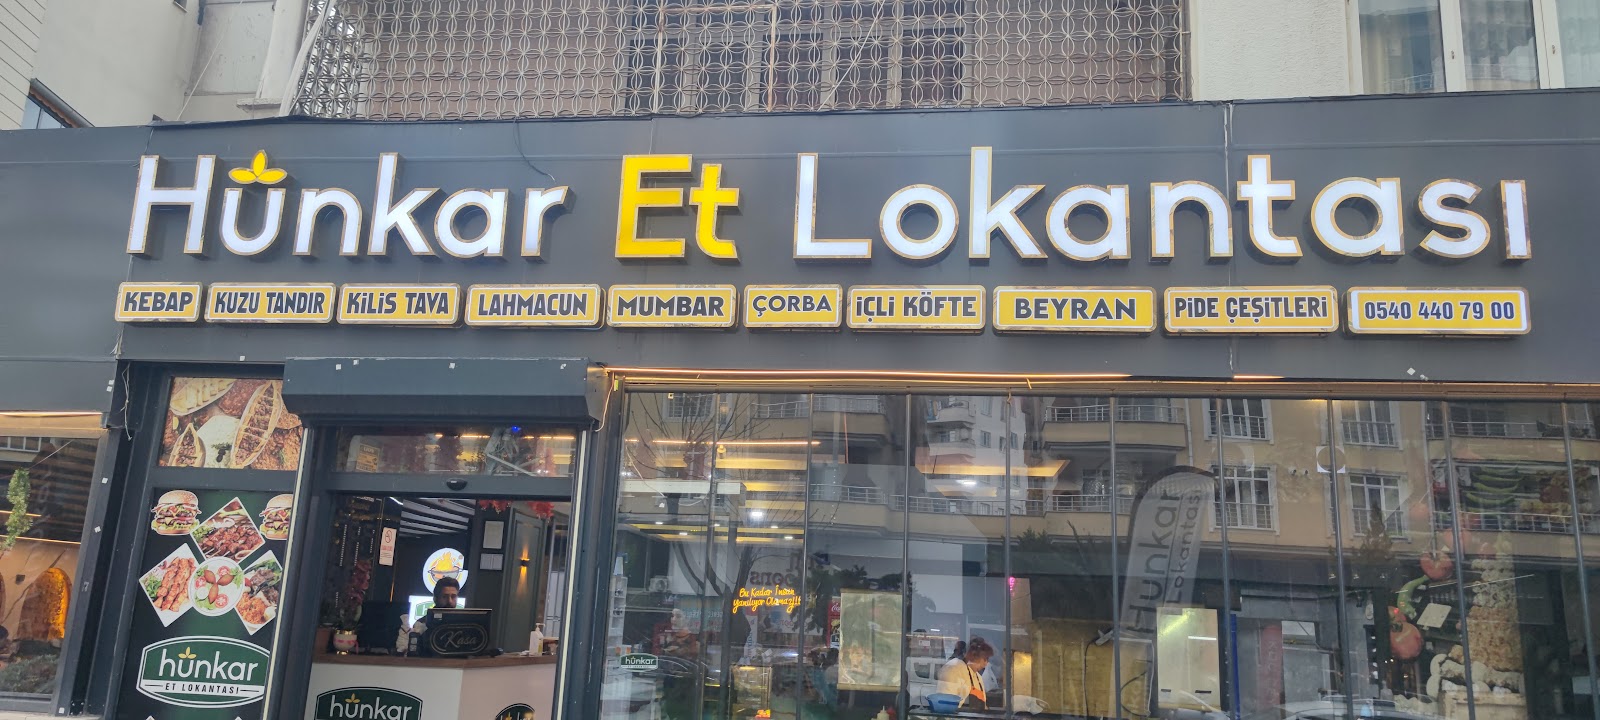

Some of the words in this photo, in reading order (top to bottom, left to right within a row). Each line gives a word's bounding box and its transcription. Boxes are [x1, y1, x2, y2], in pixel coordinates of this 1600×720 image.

[615, 154, 740, 258] Et
[793, 146, 1531, 261] Lokantası
[124, 291, 194, 312] KEBAP
[214, 291, 259, 314] KUZU
[266, 292, 325, 314] TANDIR
[405, 292, 449, 315] TAVA
[478, 293, 587, 316] LAHMACUN
[617, 296, 725, 317] MUMBAR
[752, 295, 832, 317] ÇORBA
[903, 291, 977, 317] KÖFTE
[1015, 298, 1136, 320] BEYRAN
[1364, 302, 1411, 320] 0540
[1418, 302, 1454, 320] 440
[1460, 302, 1485, 320] 79
[1490, 302, 1515, 320] 00
[739, 587, 749, 598] Bu
[750, 586, 773, 598] Kadar
[440, 630, 477, 648] Kasa
[165, 682, 176, 691] ET
[181, 683, 240, 694] LOKANTASI
